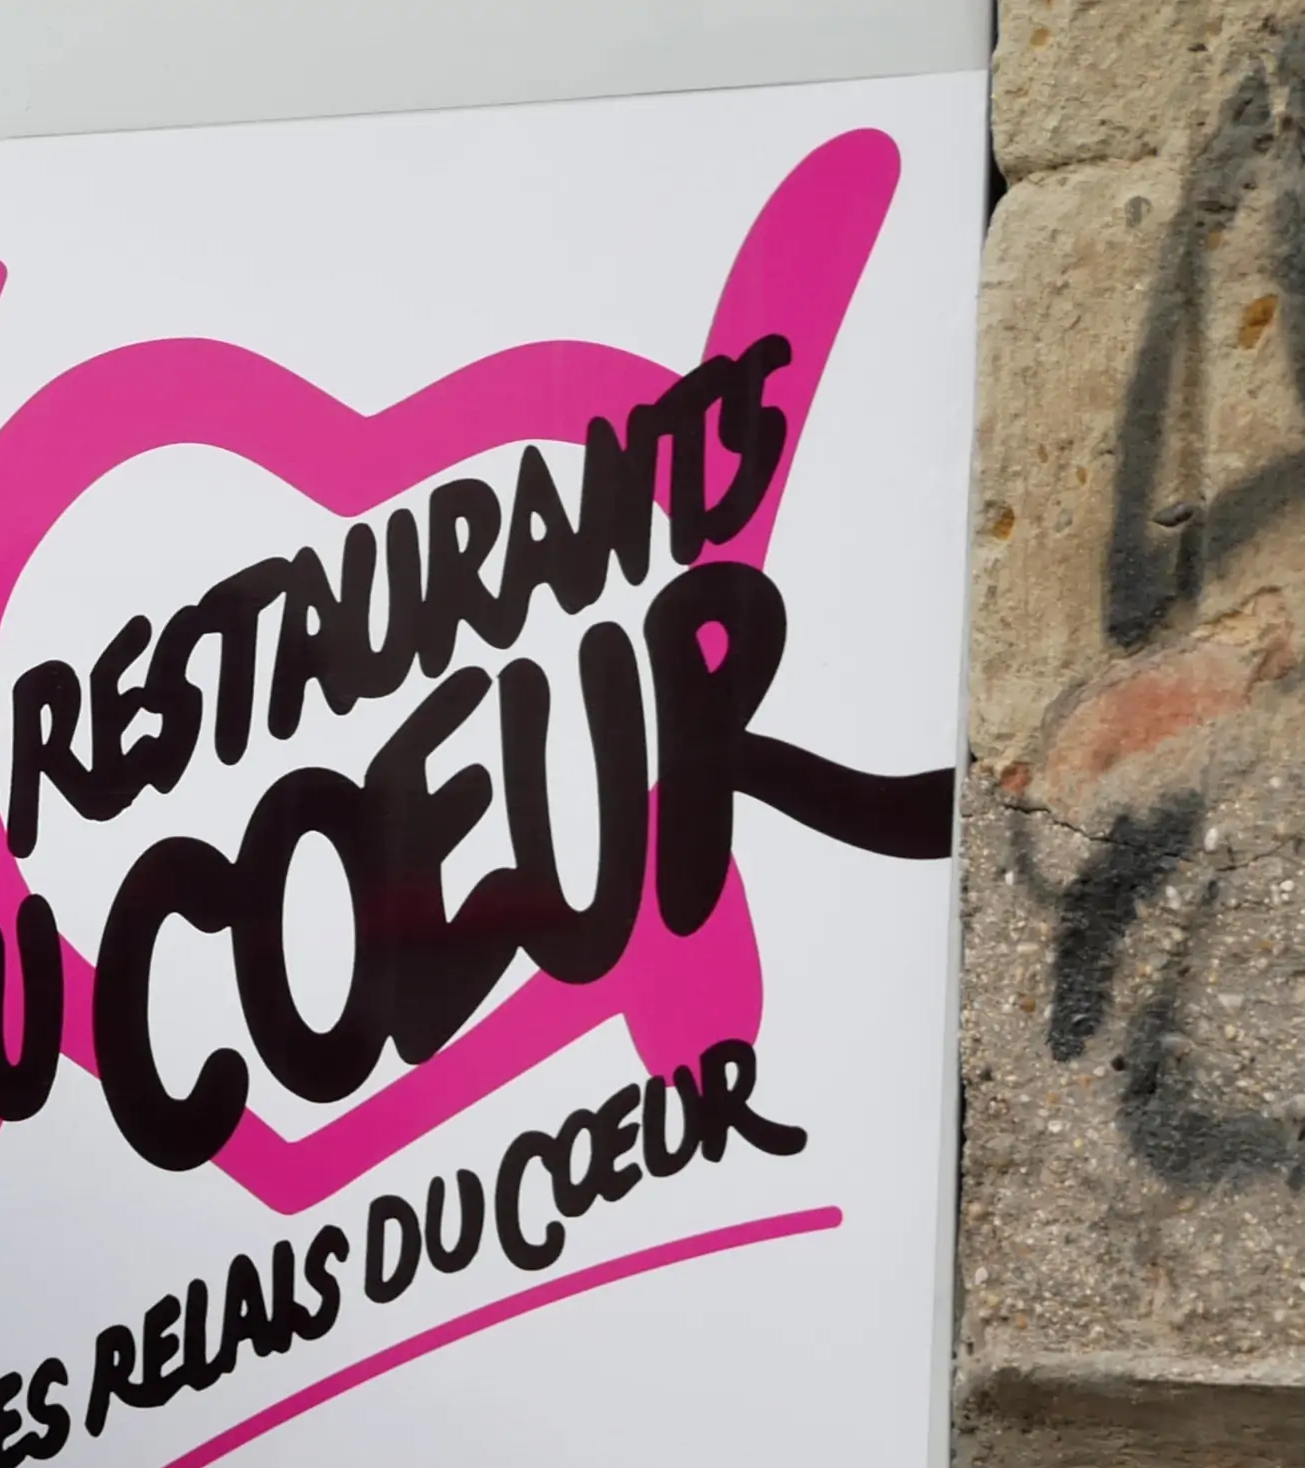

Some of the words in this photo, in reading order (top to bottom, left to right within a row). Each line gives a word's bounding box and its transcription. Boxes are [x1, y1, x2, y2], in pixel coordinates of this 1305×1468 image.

[7, 333, 792, 859] RESTAURANTS
[84, 1224, 351, 1439] RELAIS
[363, 1168, 486, 1305] DU
